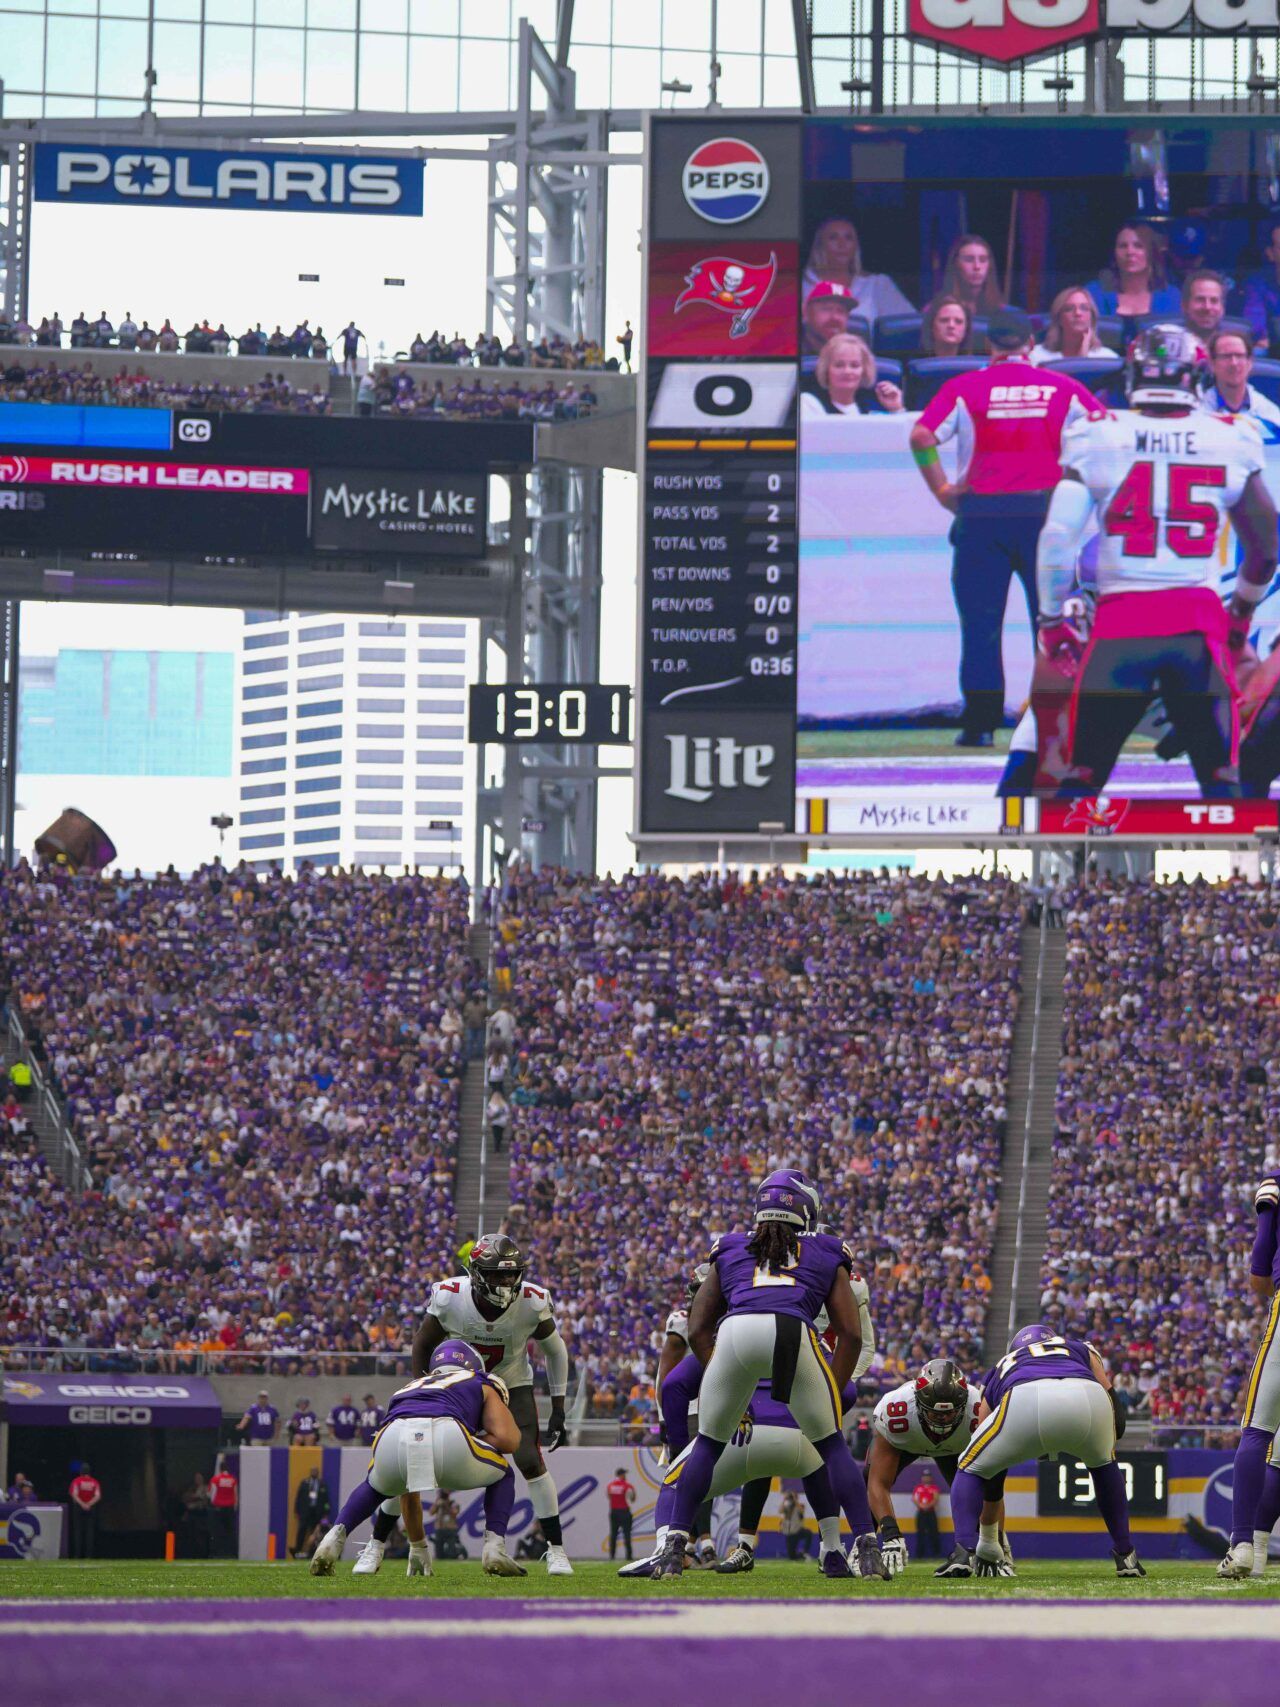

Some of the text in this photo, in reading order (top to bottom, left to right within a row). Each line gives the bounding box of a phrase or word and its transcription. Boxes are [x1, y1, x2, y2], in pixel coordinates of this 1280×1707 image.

[56, 151, 402, 206] POLARIS
[688, 171, 764, 190] PEPSI
[693, 374, 753, 417] 0
[989, 384, 1058, 402] BEST
[181, 422, 210, 439] CC
[1134, 429, 1198, 455] WHITE
[51, 461, 295, 491] RUSH LEADER
[654, 476, 693, 490] RUSH
[696, 476, 722, 490] YDS
[653, 504, 780, 523] PASS YDS 2
[1104, 460, 1228, 559] 45
[436, 521, 475, 535] HOTEL
[652, 534, 779, 554] TOTAL YDS 2
[651, 567, 676, 581] 1ST
[678, 567, 732, 581] DOWNS
[651, 595, 792, 616] PEN/YDS 0/0
[651, 628, 737, 642] TURNOVERS
[651, 657, 794, 676] T.O.P. 0:36
[496, 689, 621, 738] 13:01
[663, 733, 776, 803] Lite
[1182, 805, 1235, 825] TB
[58, 1384, 190, 1399] GEICO
[68, 1405, 152, 1425] GEICO
[886, 1400, 910, 1434] 90
